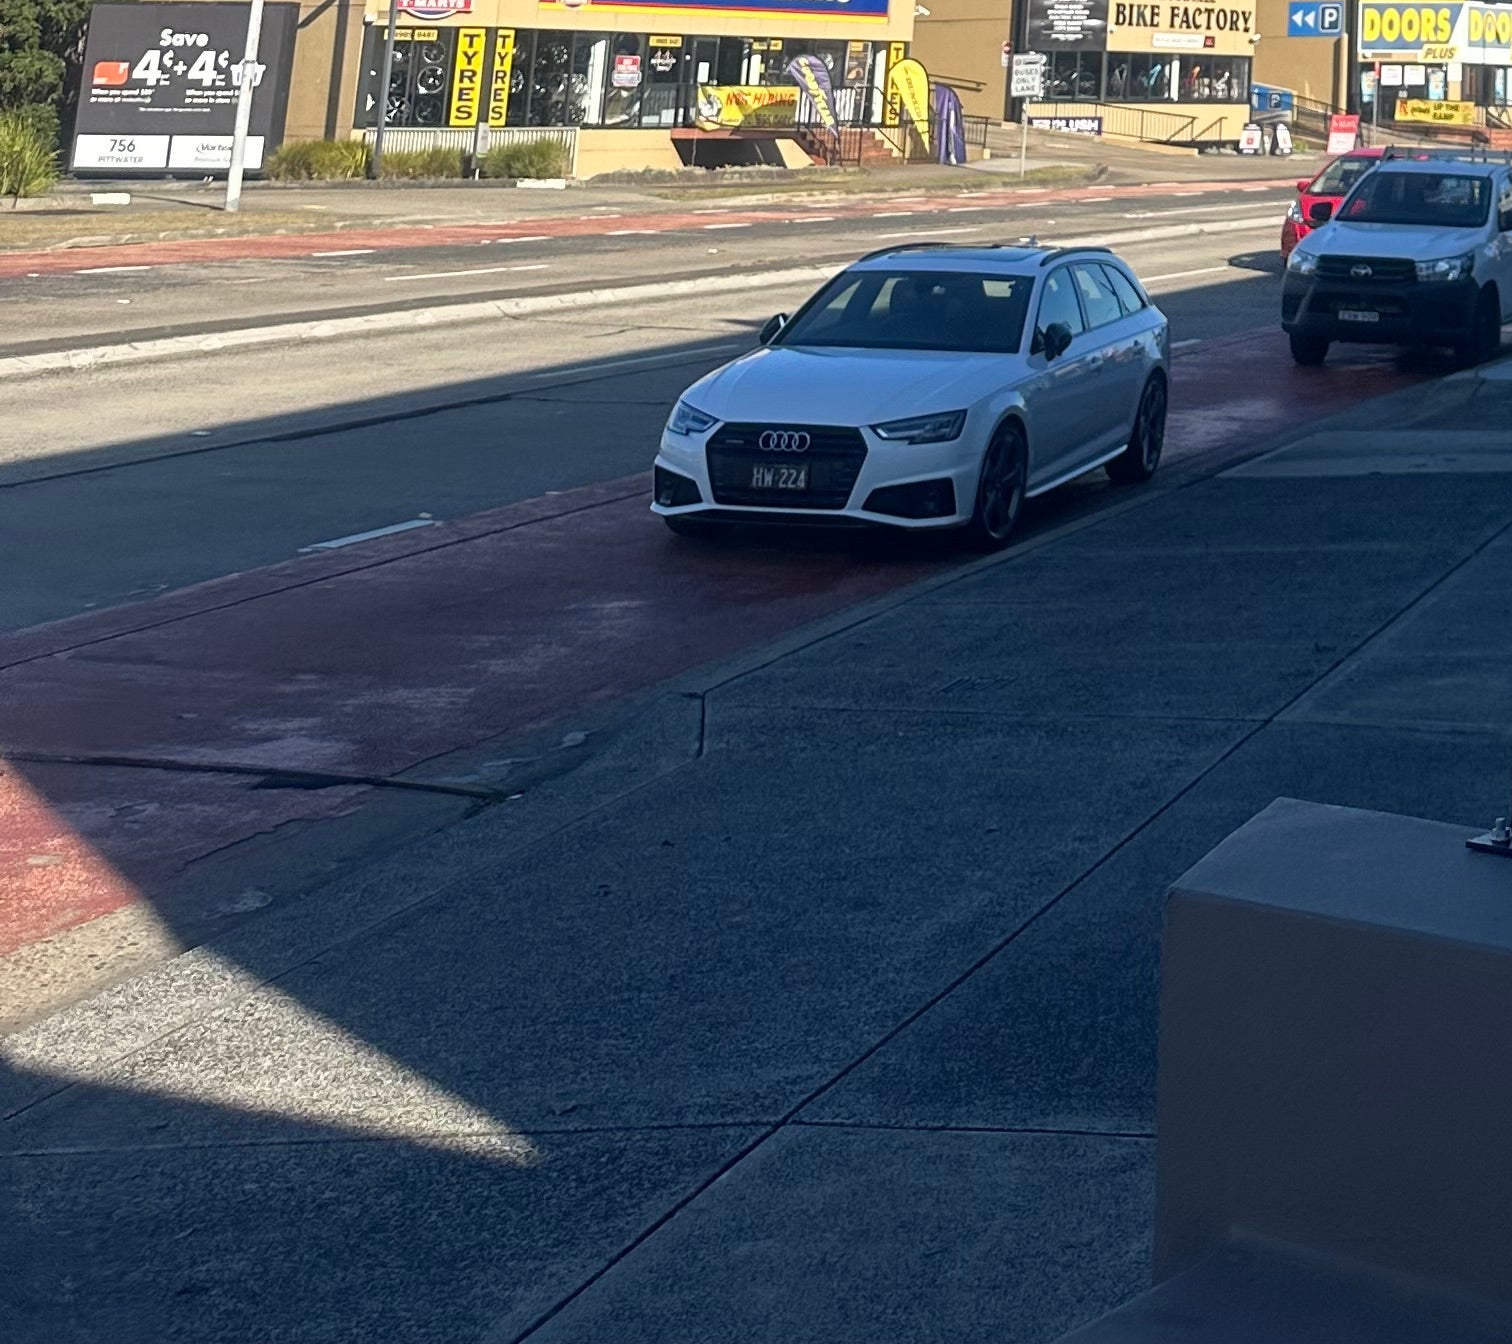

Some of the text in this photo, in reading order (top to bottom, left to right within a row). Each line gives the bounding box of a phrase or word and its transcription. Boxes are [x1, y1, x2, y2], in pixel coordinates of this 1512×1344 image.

[1115, 2, 1252, 33] BIKE FACTORY
[1363, 7, 1452, 43] DOORS
[160, 28, 209, 47] Save
[1423, 47, 1456, 60] PLUS
[454, 33, 482, 122] TYRES
[490, 33, 511, 122] TYRES
[110, 139, 136, 152] 756
